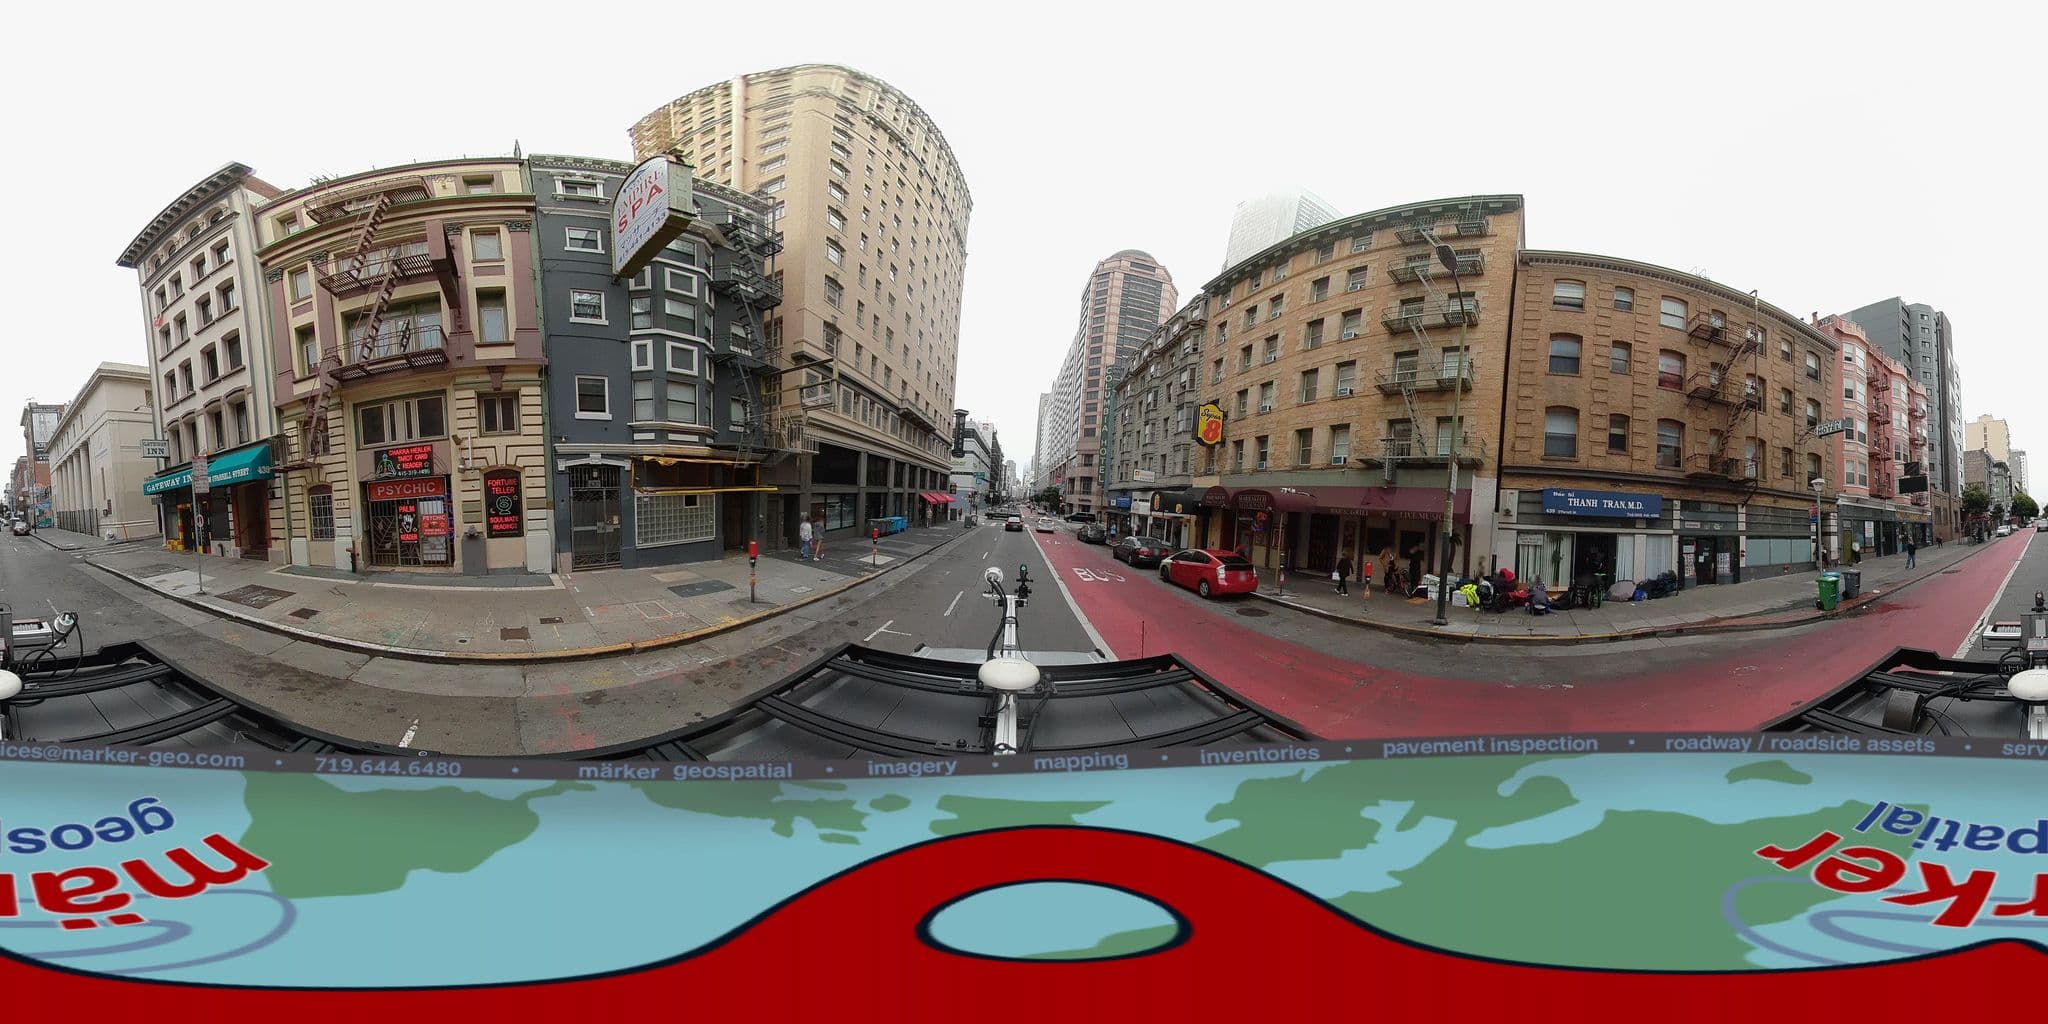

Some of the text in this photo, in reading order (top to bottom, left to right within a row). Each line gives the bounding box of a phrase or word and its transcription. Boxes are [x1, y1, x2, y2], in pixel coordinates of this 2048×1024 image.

[618, 184, 664, 234] SPA
[1102, 367, 1112, 432] COLUMBIA
[1200, 408, 1221, 421] Super
[1202, 419, 1221, 442] 8
[147, 447, 165, 455] INN
[410, 445, 432, 453] HEALER
[402, 461, 423, 469] READER
[1098, 439, 1107, 483] HOTEL
[146, 476, 181, 492] GATEWAY
[377, 482, 436, 496] PSYCHIC
[1567, 498, 1598, 507] THANH
[1627, 501, 1644, 510] M.D.
[1400, 512, 1416, 520] LIVE
[400, 533, 418, 541] READER
[1071, 567, 1126, 582] BUS
